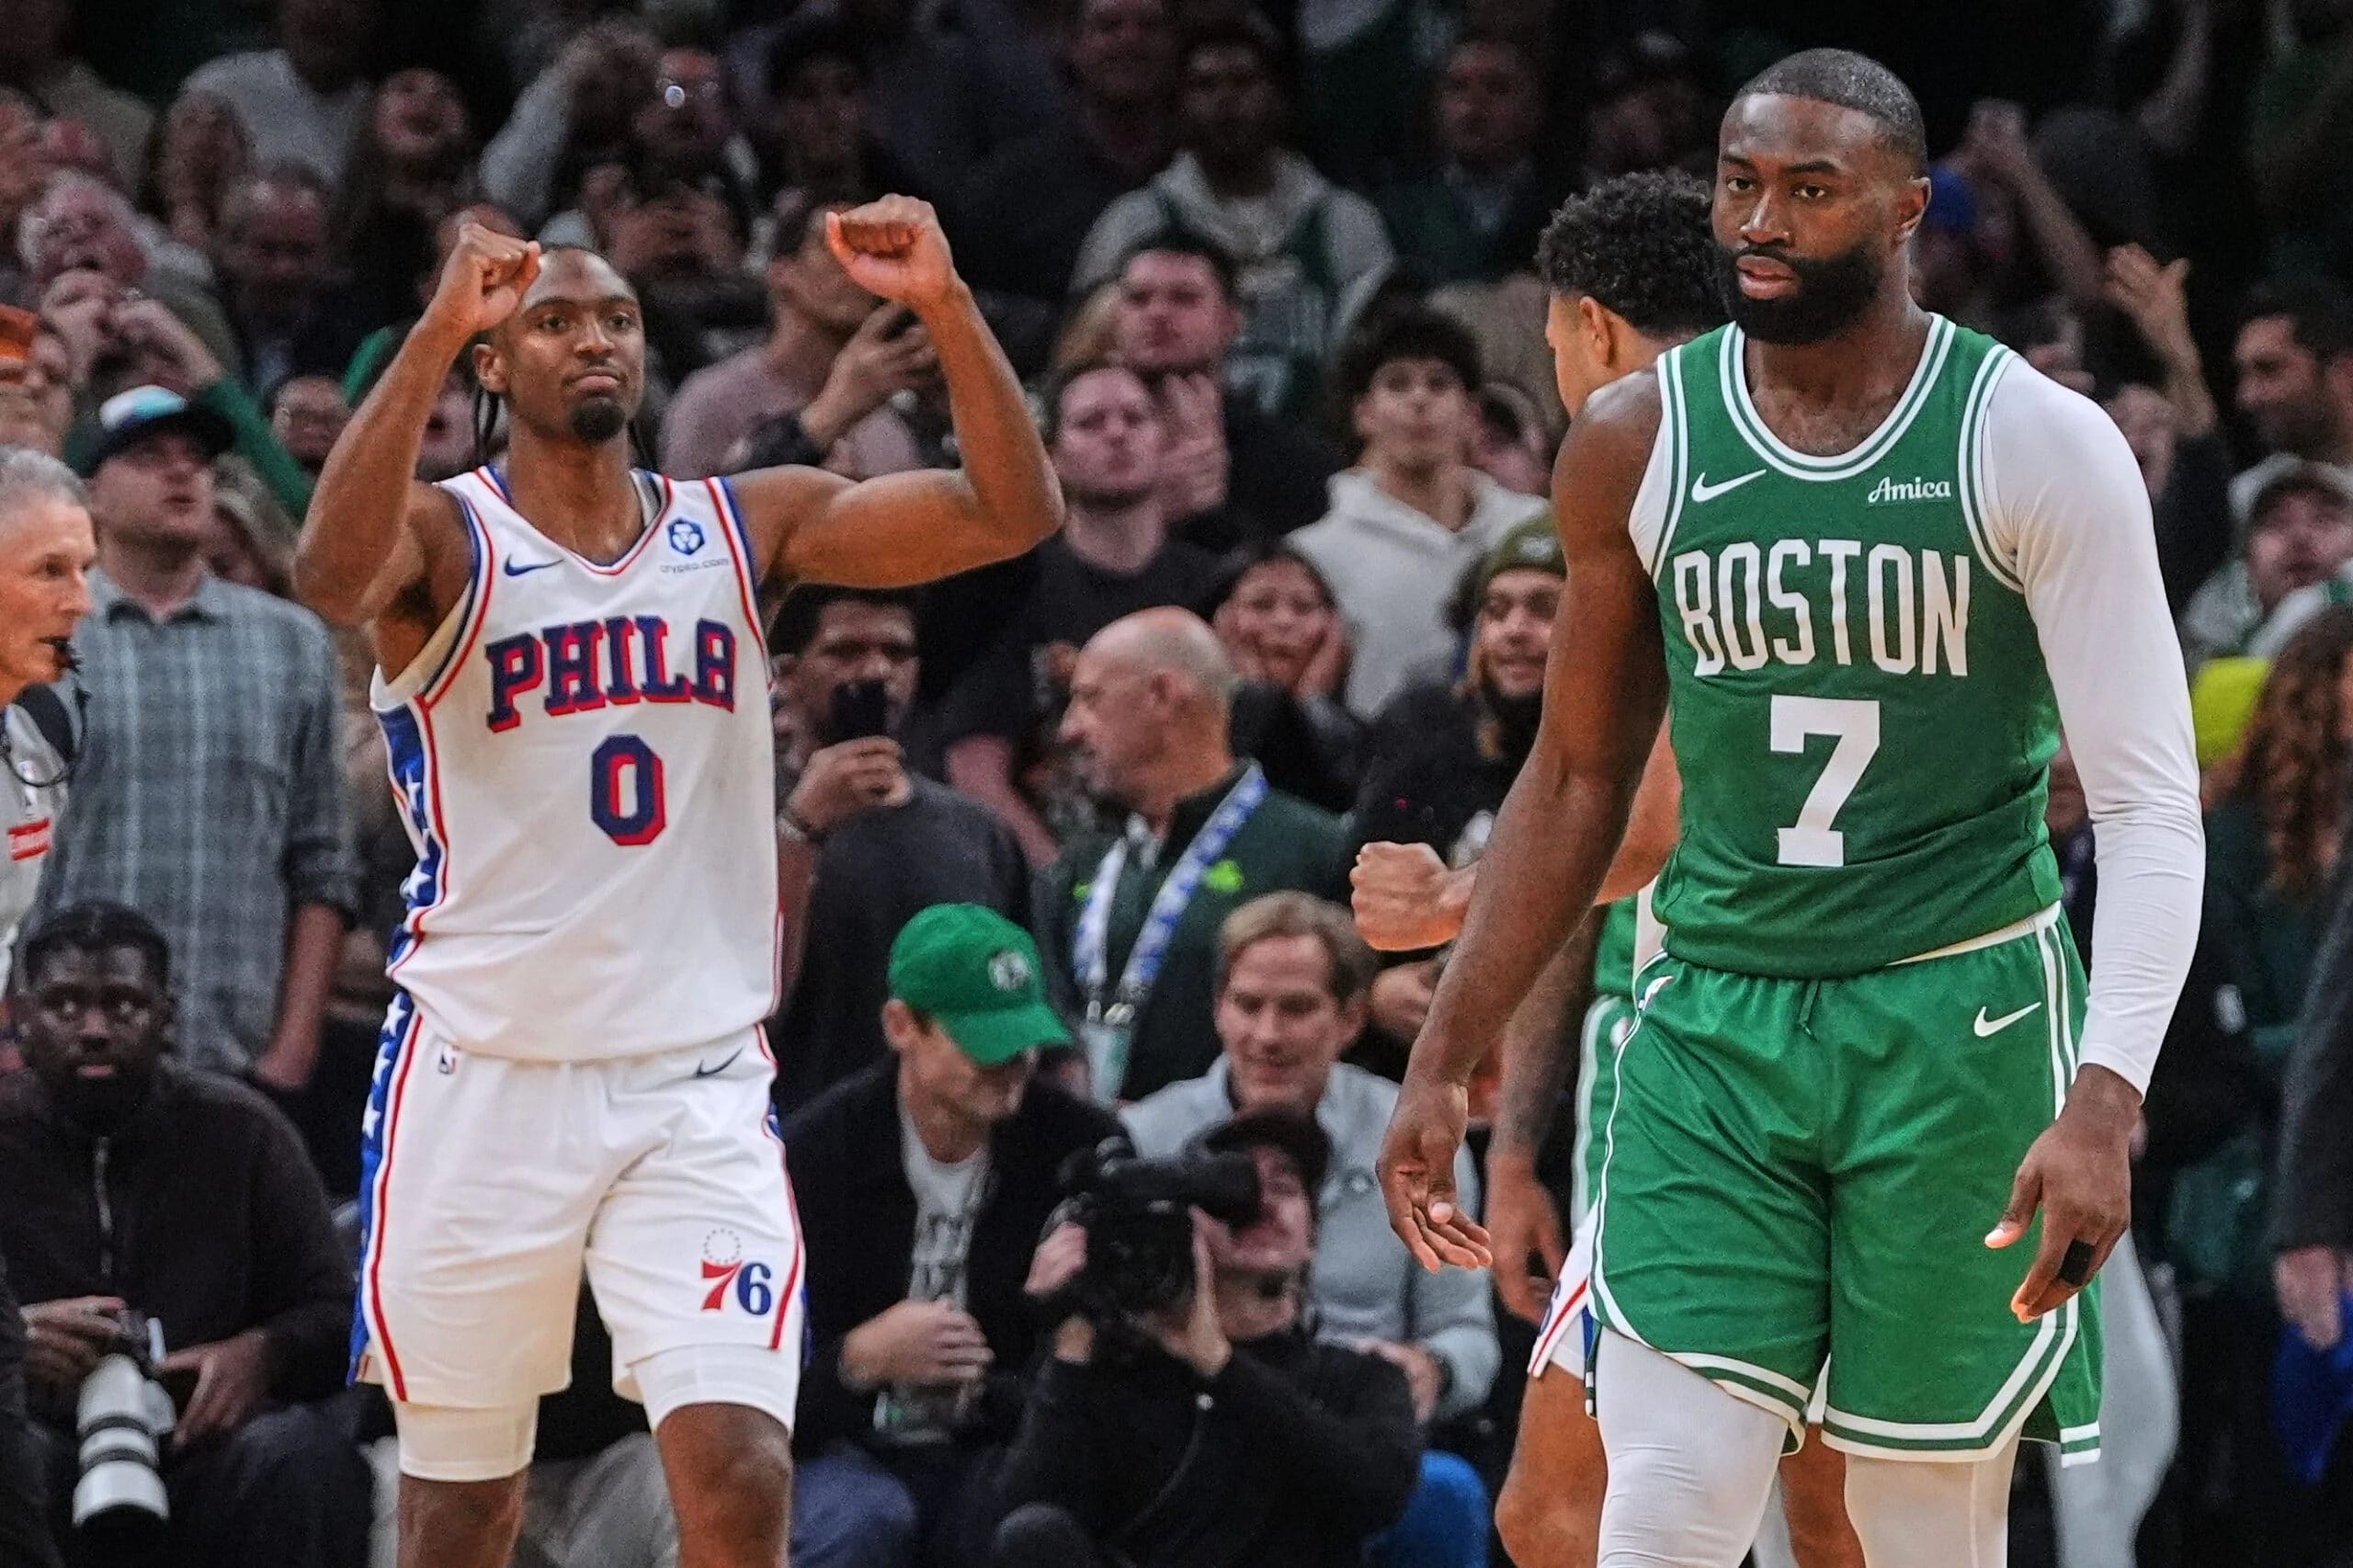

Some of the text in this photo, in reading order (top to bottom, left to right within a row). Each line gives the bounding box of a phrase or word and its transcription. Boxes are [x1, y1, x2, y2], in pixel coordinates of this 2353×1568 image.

[1868, 476, 1951, 504] Amica
[1673, 539, 1970, 676] BOSTON
[485, 615, 735, 733] PHILA
[591, 734, 665, 846] 0
[1770, 695, 1880, 868] 7
[701, 1257, 771, 1316] 76
